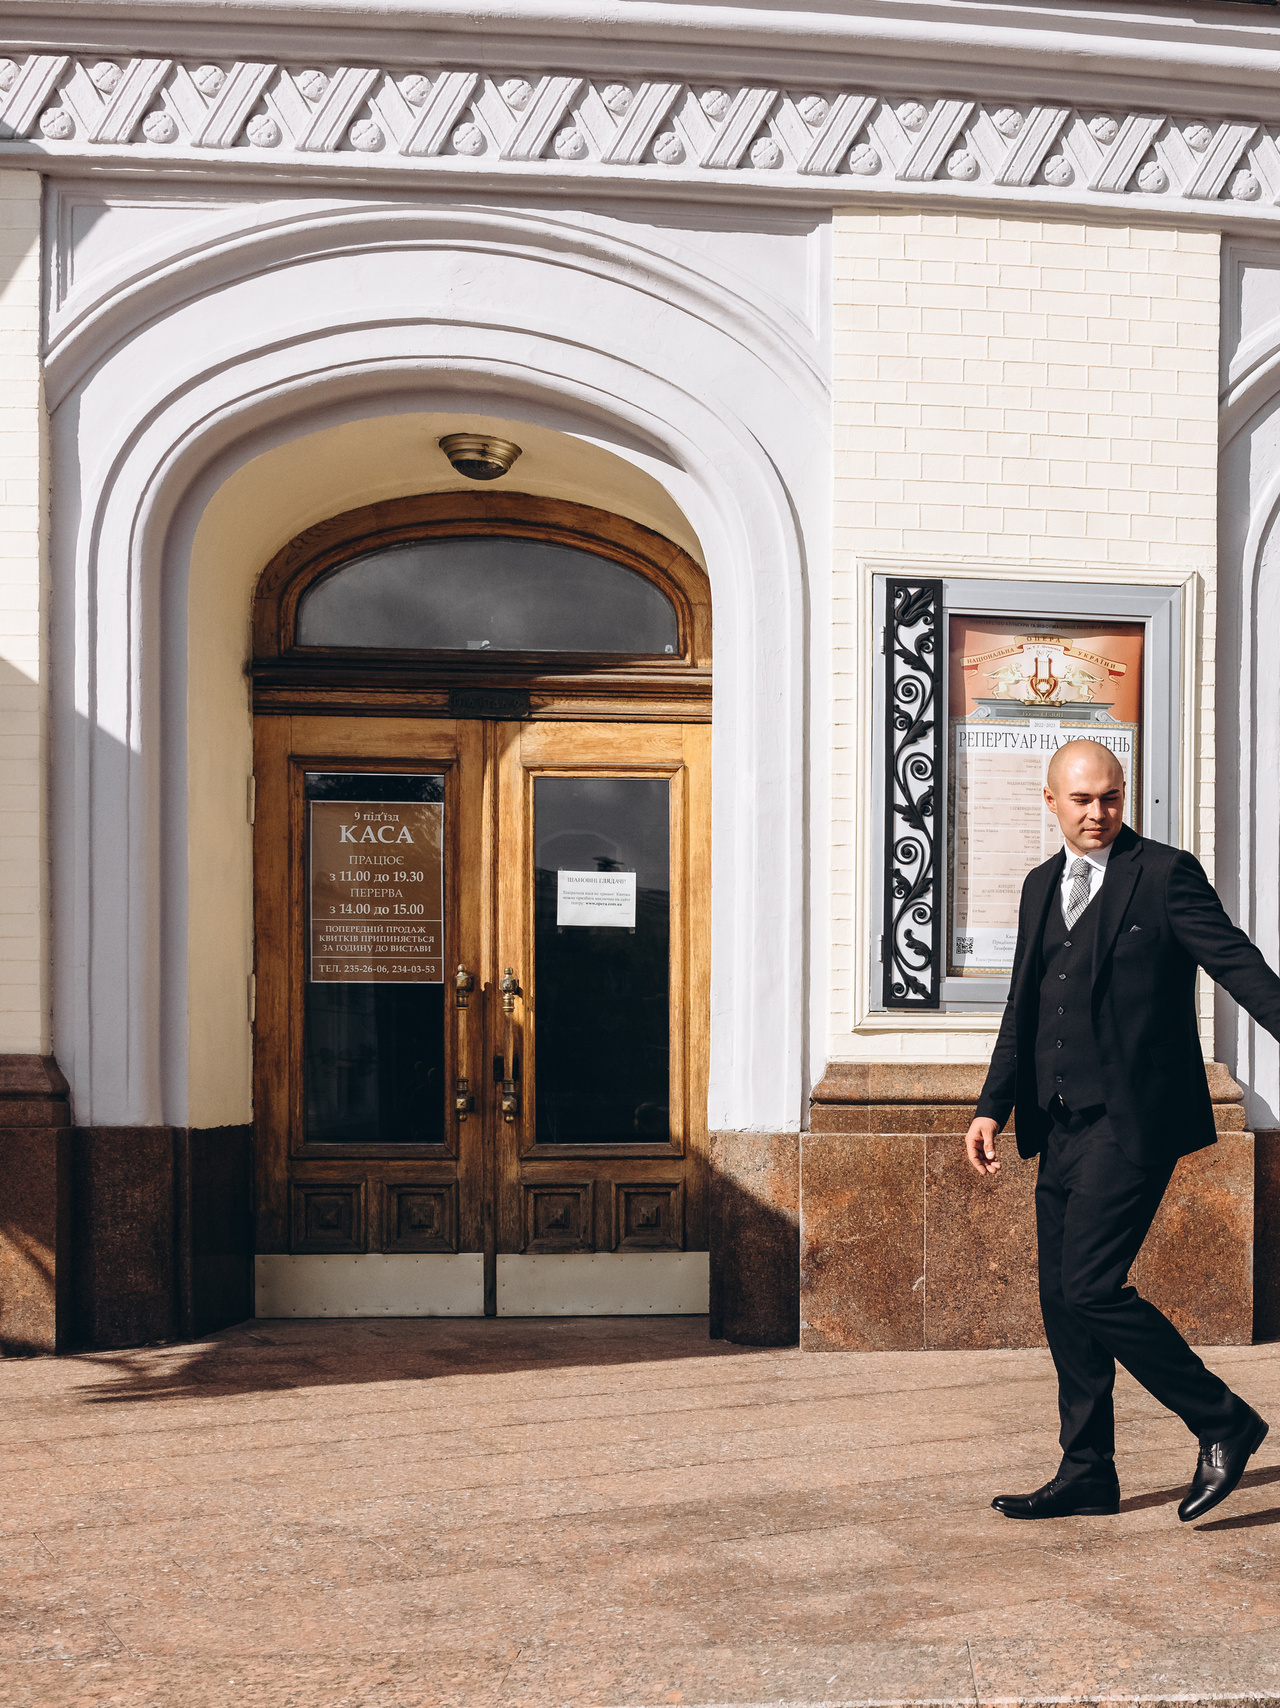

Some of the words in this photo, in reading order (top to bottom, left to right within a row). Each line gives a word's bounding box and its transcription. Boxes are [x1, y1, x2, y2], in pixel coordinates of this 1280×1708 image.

[967, 647, 1015, 664] НАЦІОНАЛЬНА
[1078, 651, 1116, 669] УКРАЇНИ
[959, 731, 1037, 749] РЕПЕРТУАР
[1040, 733, 1059, 750] НА
[354, 811, 360, 821] 9
[339, 825, 415, 844] КАСА
[349, 855, 405, 866] ПРАЦЮЄ
[329, 873, 336, 882] з
[339, 870, 371, 882] 11.00
[373, 873, 390, 883] до
[393, 871, 424, 882] 19.30
[350, 887, 404, 898] ПЕРЕРВА
[329, 905, 336, 914] з
[339, 903, 371, 914] 14.00
[373, 906, 390, 915] до
[393, 903, 424, 915] 15.00
[325, 924, 384, 934] ПОПЕРЕДНІЙ
[386, 926, 426, 934] ПРОДАЖ
[319, 934, 359, 942] КВИТКІВ
[361, 935, 435, 943] ПРИПИНЯЄТЬСЯ
[322, 944, 334, 952] ЗА
[336, 944, 373, 953] ГОДИНУ
[375, 945, 388, 953] ДО
[390, 945, 432, 953] ВИСТАВИ
[318, 964, 342, 973] ТЕЛ.
[344, 965, 389, 974] 235-26-06,
[392, 965, 435, 974] 234-03-53
